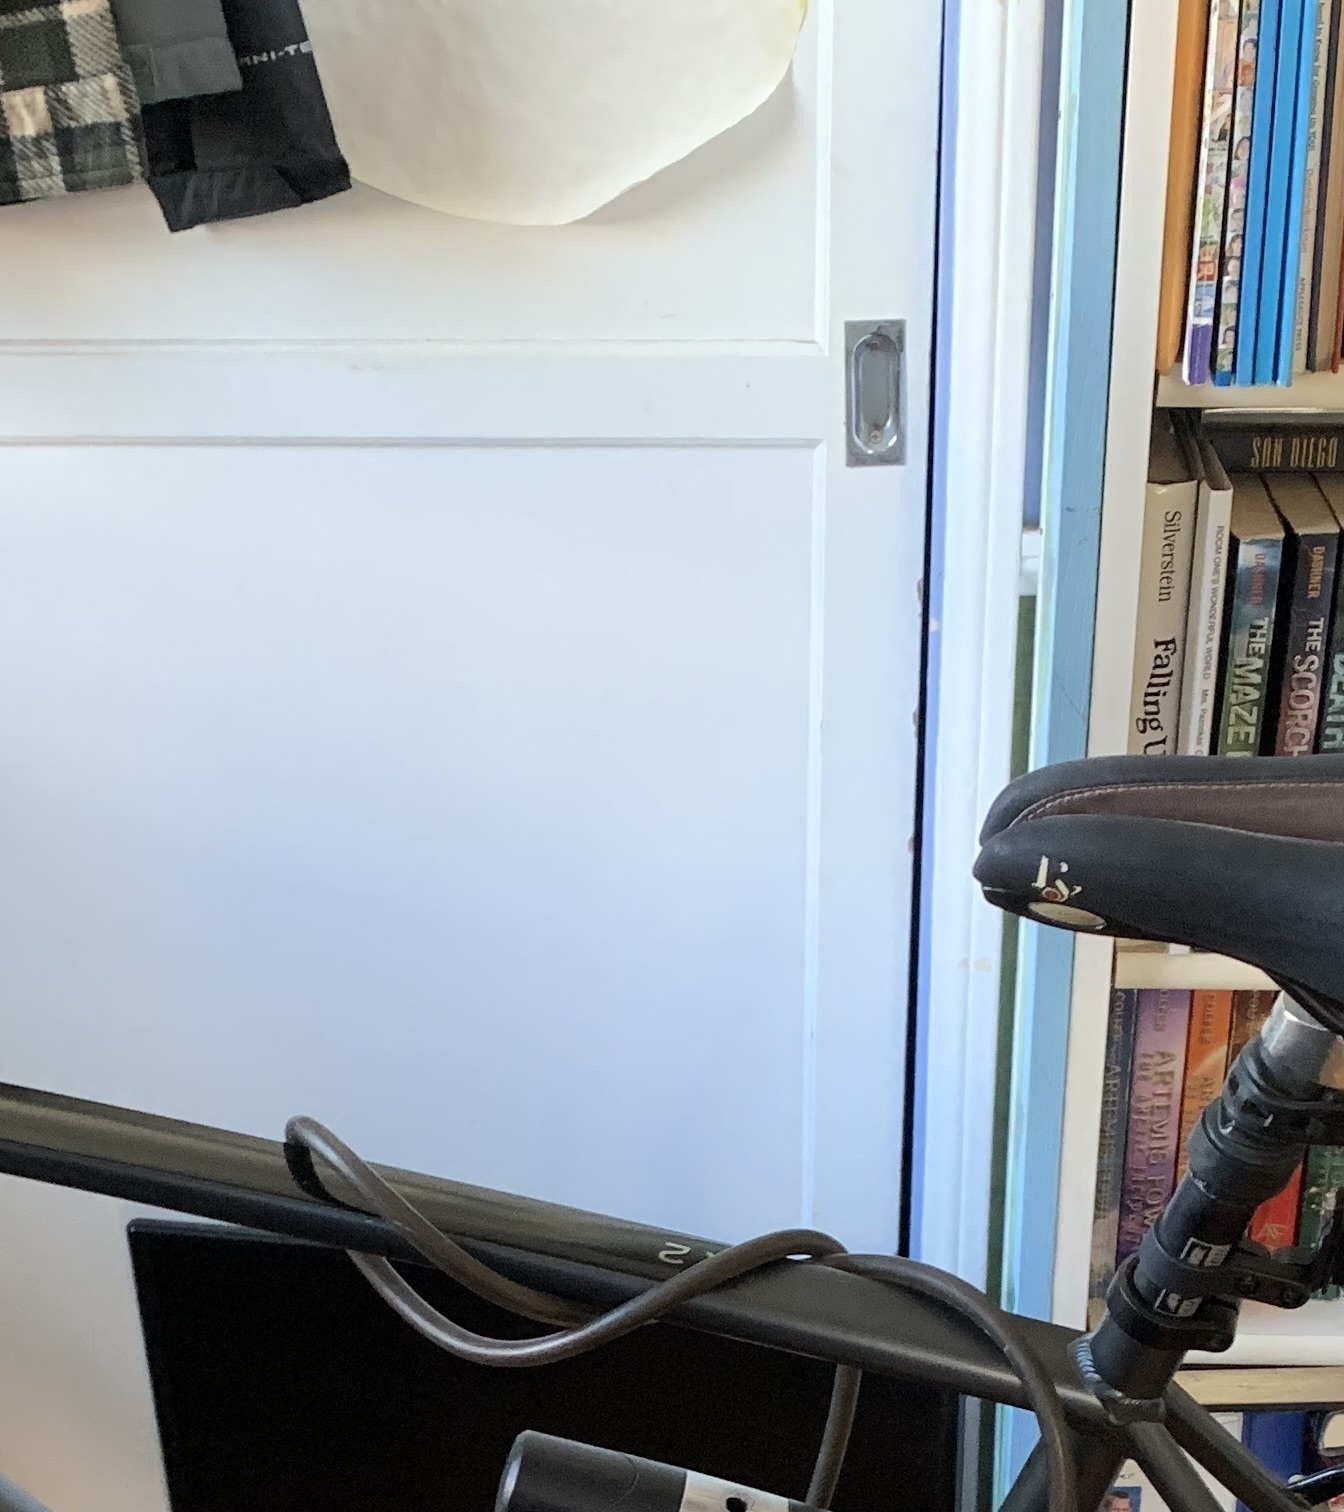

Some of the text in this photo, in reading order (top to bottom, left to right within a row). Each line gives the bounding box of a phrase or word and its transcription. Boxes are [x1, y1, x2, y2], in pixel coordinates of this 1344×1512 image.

[1290, 438, 1338, 468] DIEGO
[1158, 510, 1182, 602] Silverstein
[1307, 546, 1326, 599] DASHNER
[1305, 617, 1325, 652] THE
[1135, 637, 1177, 735] Falling
[1227, 617, 1270, 746] THE MAZE
